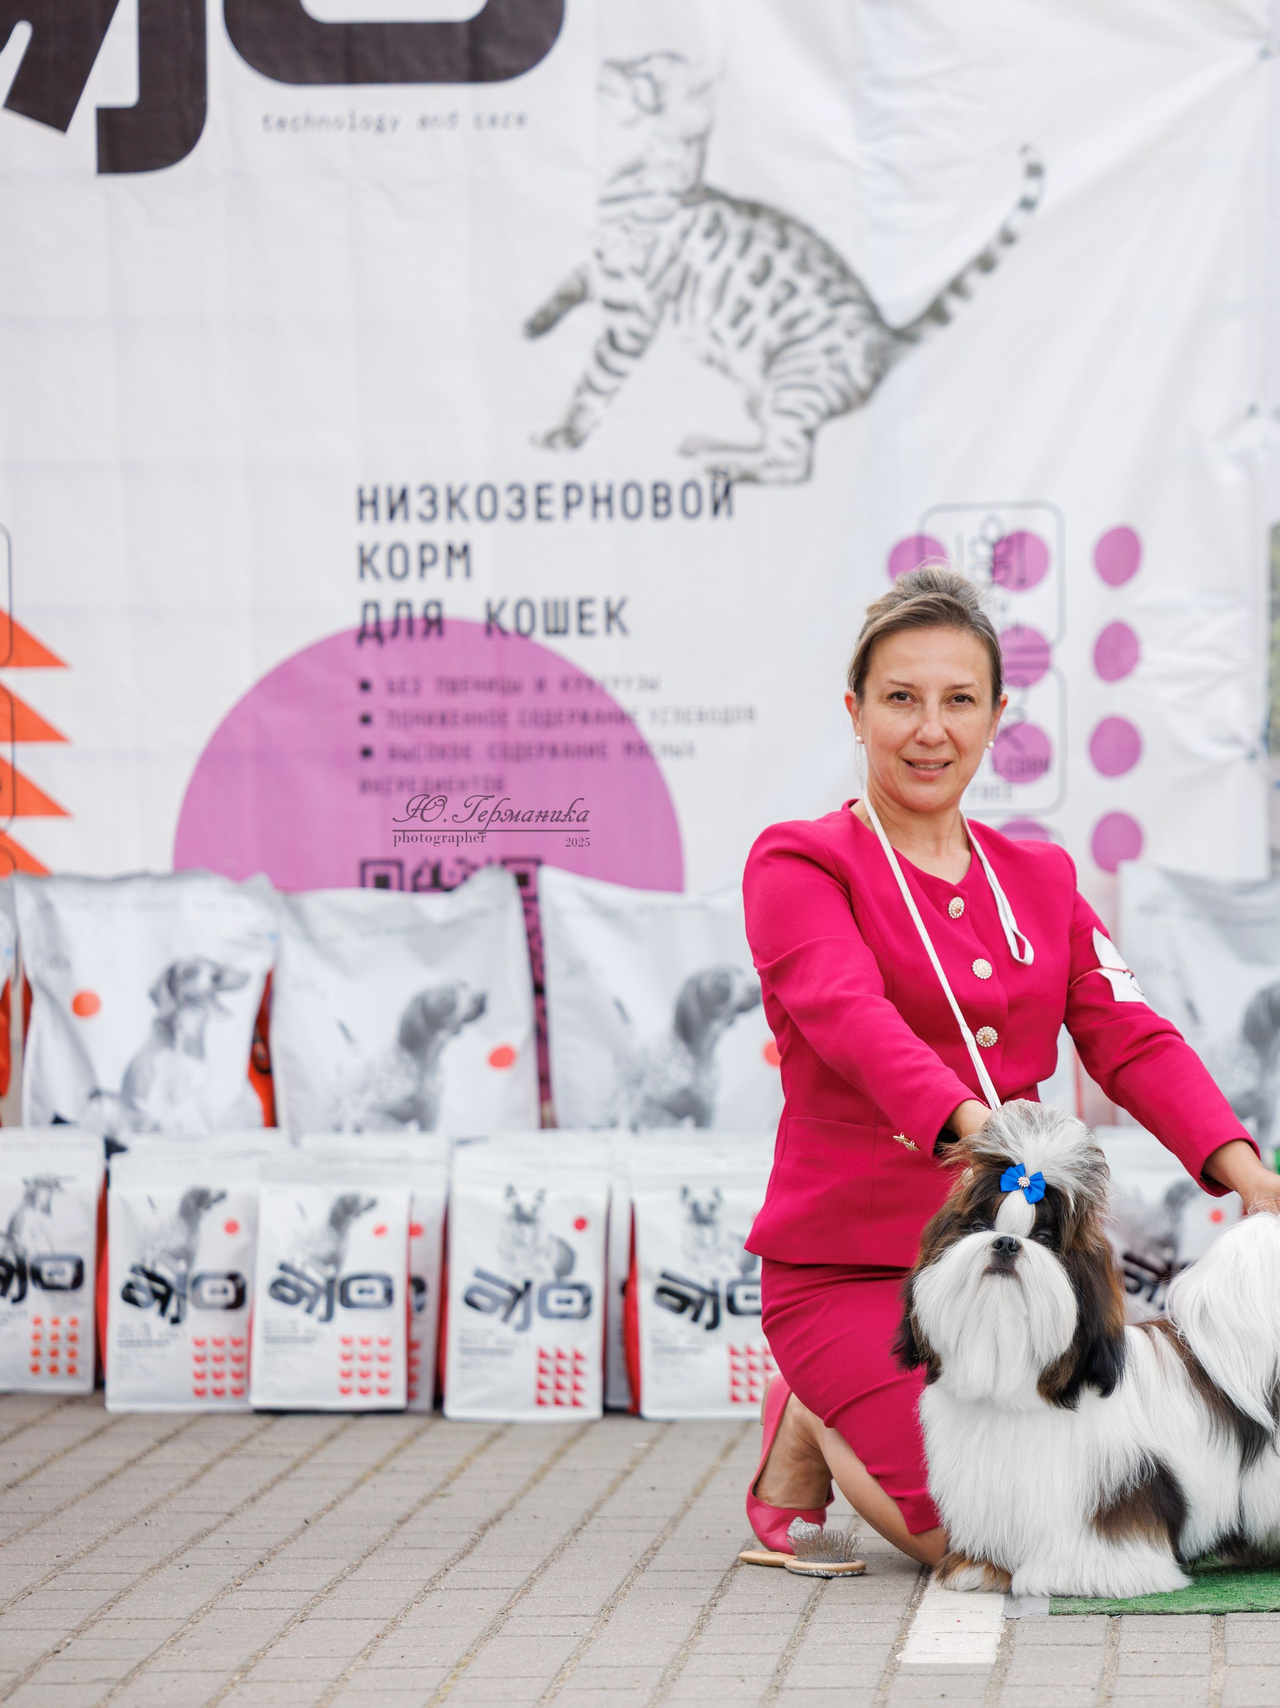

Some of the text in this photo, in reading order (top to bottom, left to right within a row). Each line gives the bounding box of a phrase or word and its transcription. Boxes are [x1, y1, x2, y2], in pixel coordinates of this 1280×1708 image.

[262, 109, 528, 134] technology and care
[357, 472, 735, 523] НИЗКОЗЕРНОВОЙ
[357, 541, 473, 581] КОРМ
[357, 598, 631, 646] ДЛЯ КОШЕК
